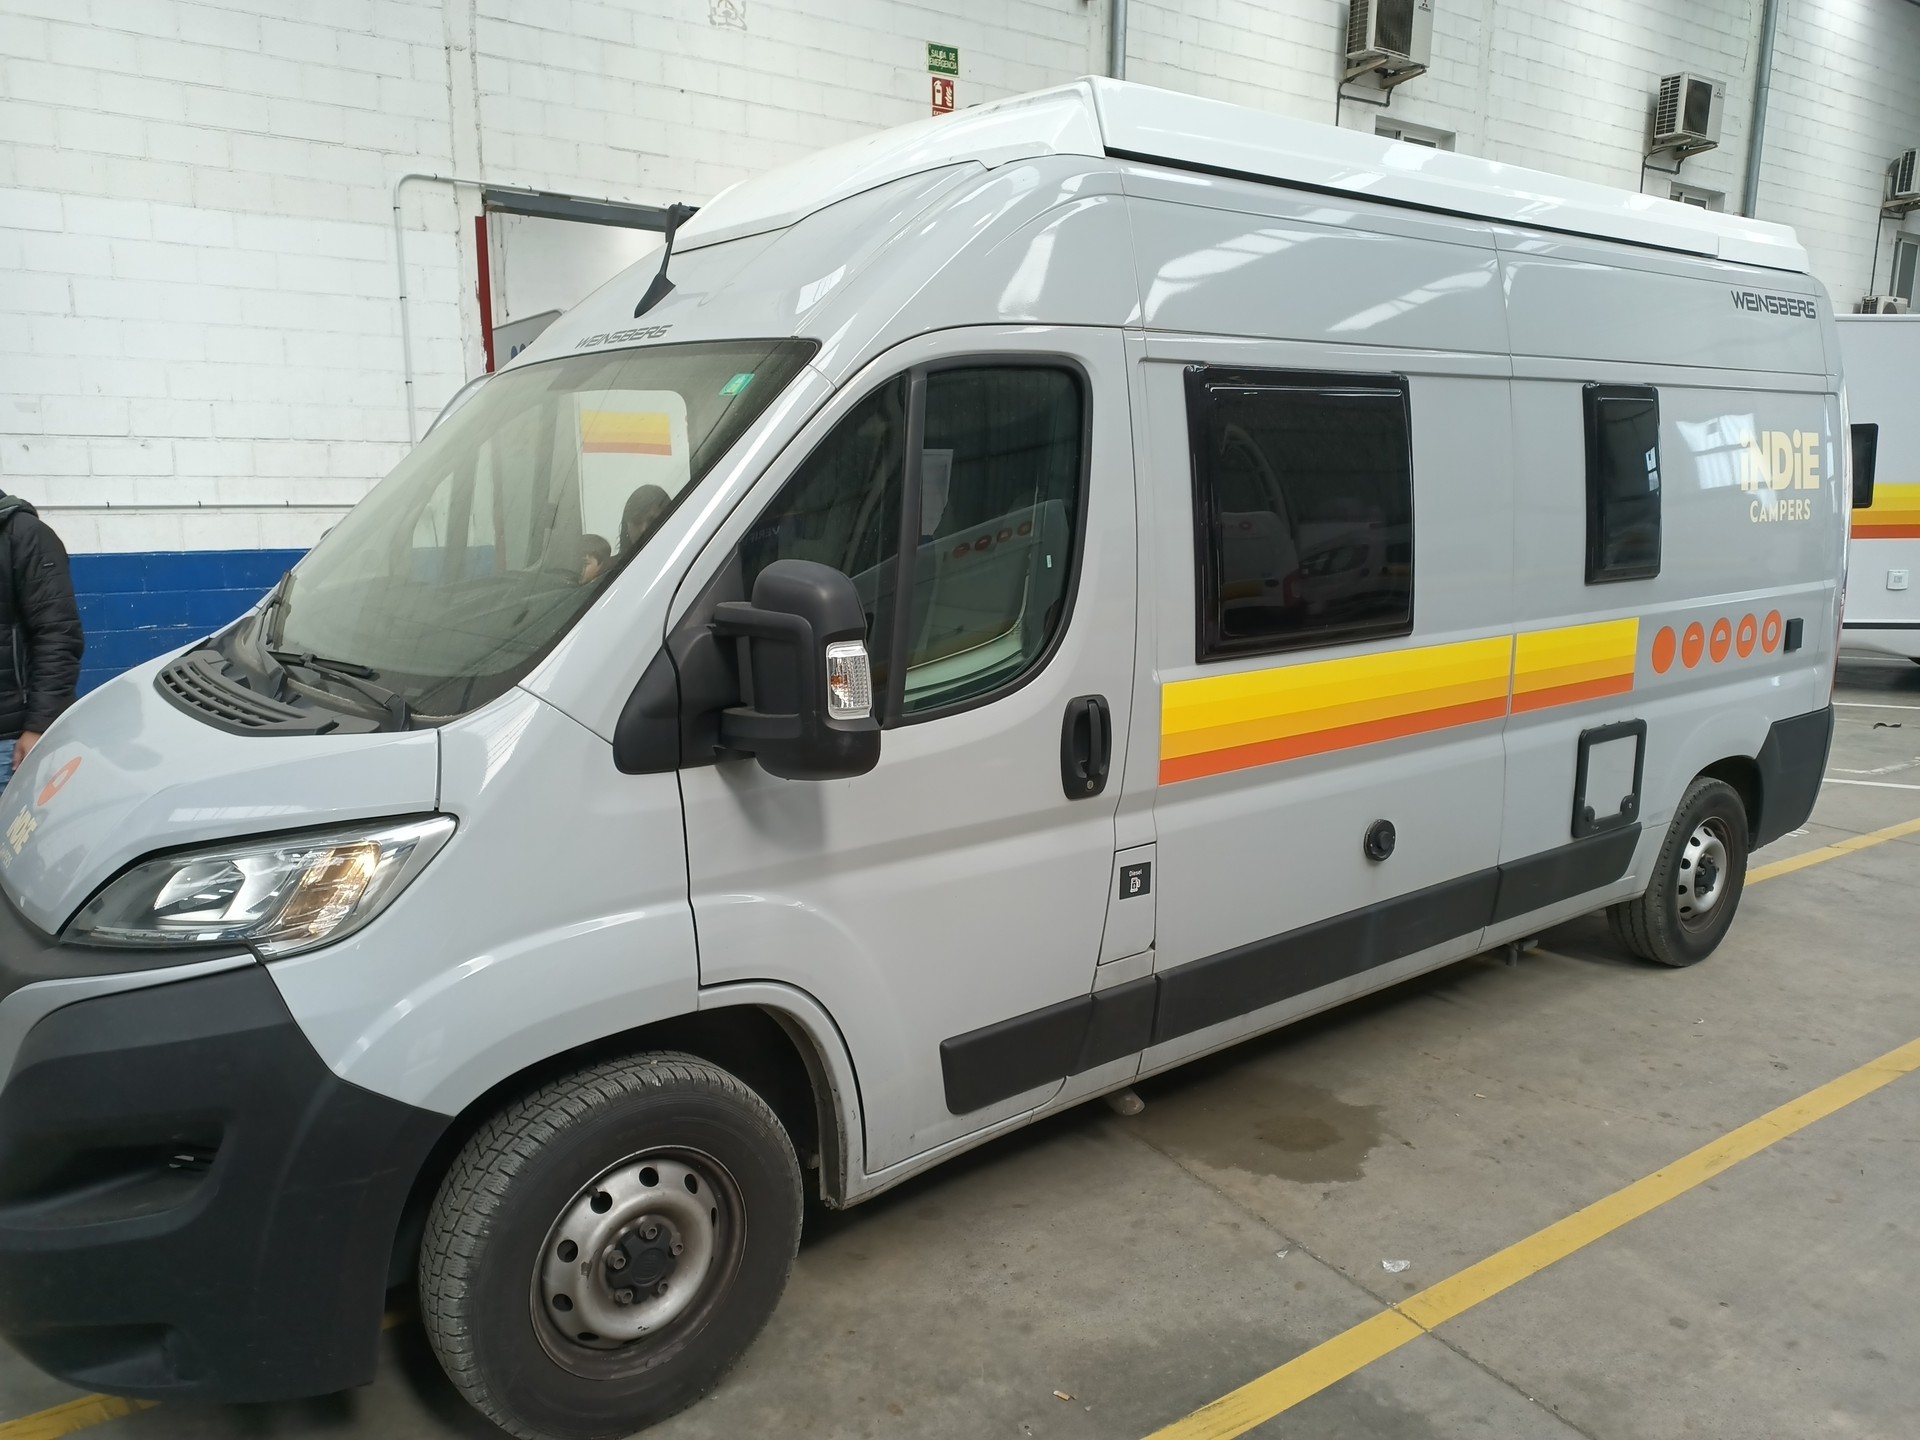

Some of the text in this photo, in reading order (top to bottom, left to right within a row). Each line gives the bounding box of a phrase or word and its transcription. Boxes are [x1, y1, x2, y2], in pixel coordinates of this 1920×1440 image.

[931, 49, 956, 61] SALIDA DE
[1730, 290, 1816, 319] WEINSBERG
[574, 324, 673, 349] WEINSBERG
[1750, 499, 1811, 522] CAMPERS
